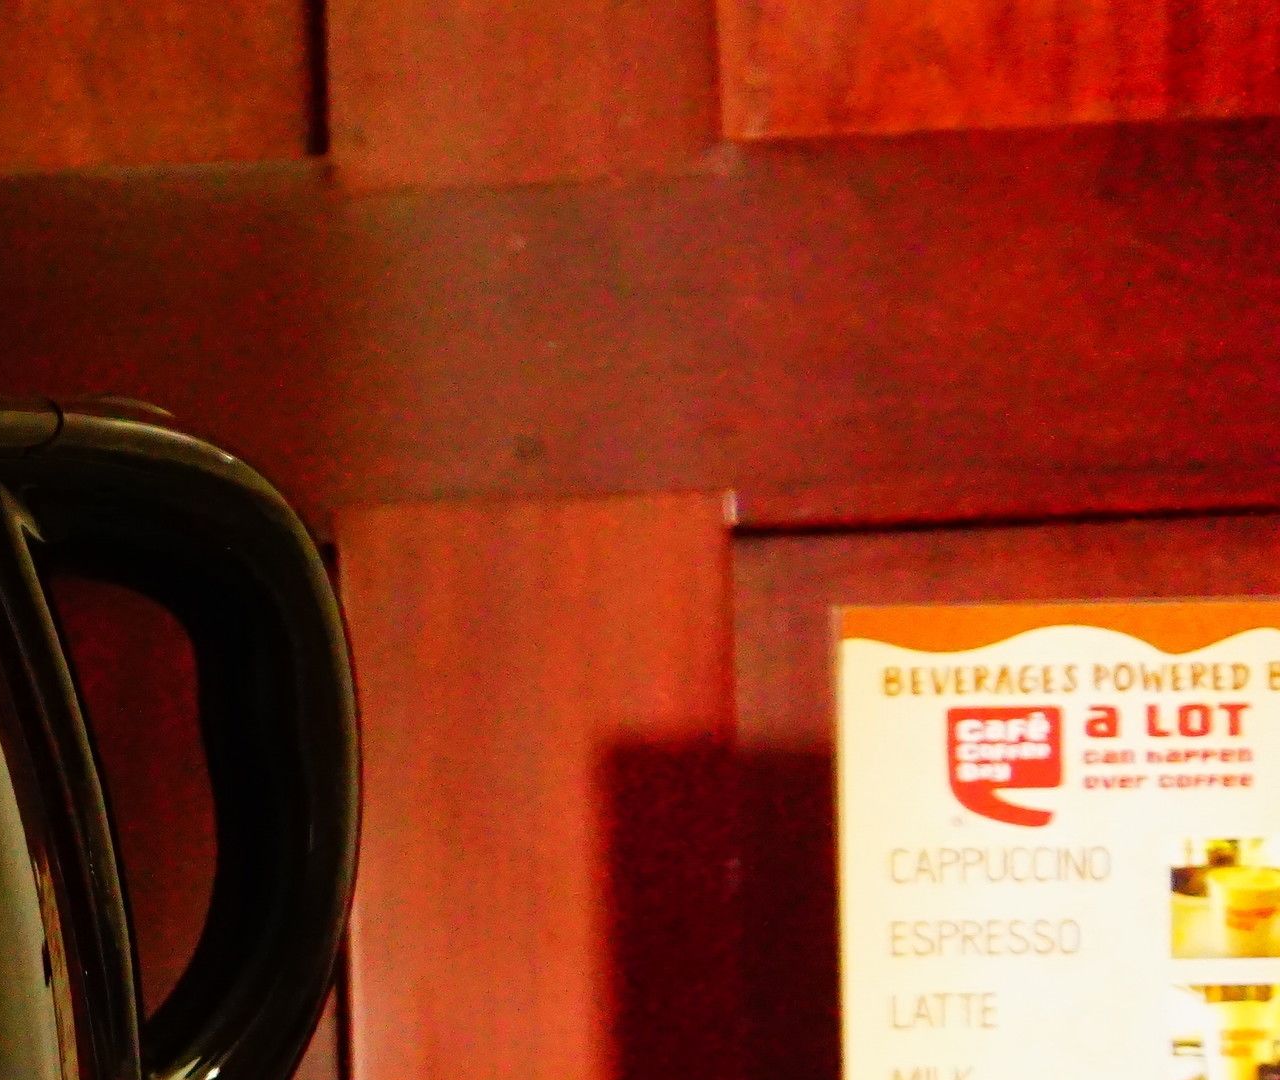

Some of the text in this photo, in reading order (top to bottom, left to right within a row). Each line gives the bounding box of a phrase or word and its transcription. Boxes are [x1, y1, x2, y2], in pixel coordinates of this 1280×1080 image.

[883, 664, 1078, 696] BEVERAGES
[1093, 661, 1249, 692] POWERED
[1085, 703, 1251, 738] a LOT
[890, 846, 1112, 884] CAPPUCCINO
[890, 919, 1082, 956] ESPRESSO
[891, 992, 999, 1029] LATTE
